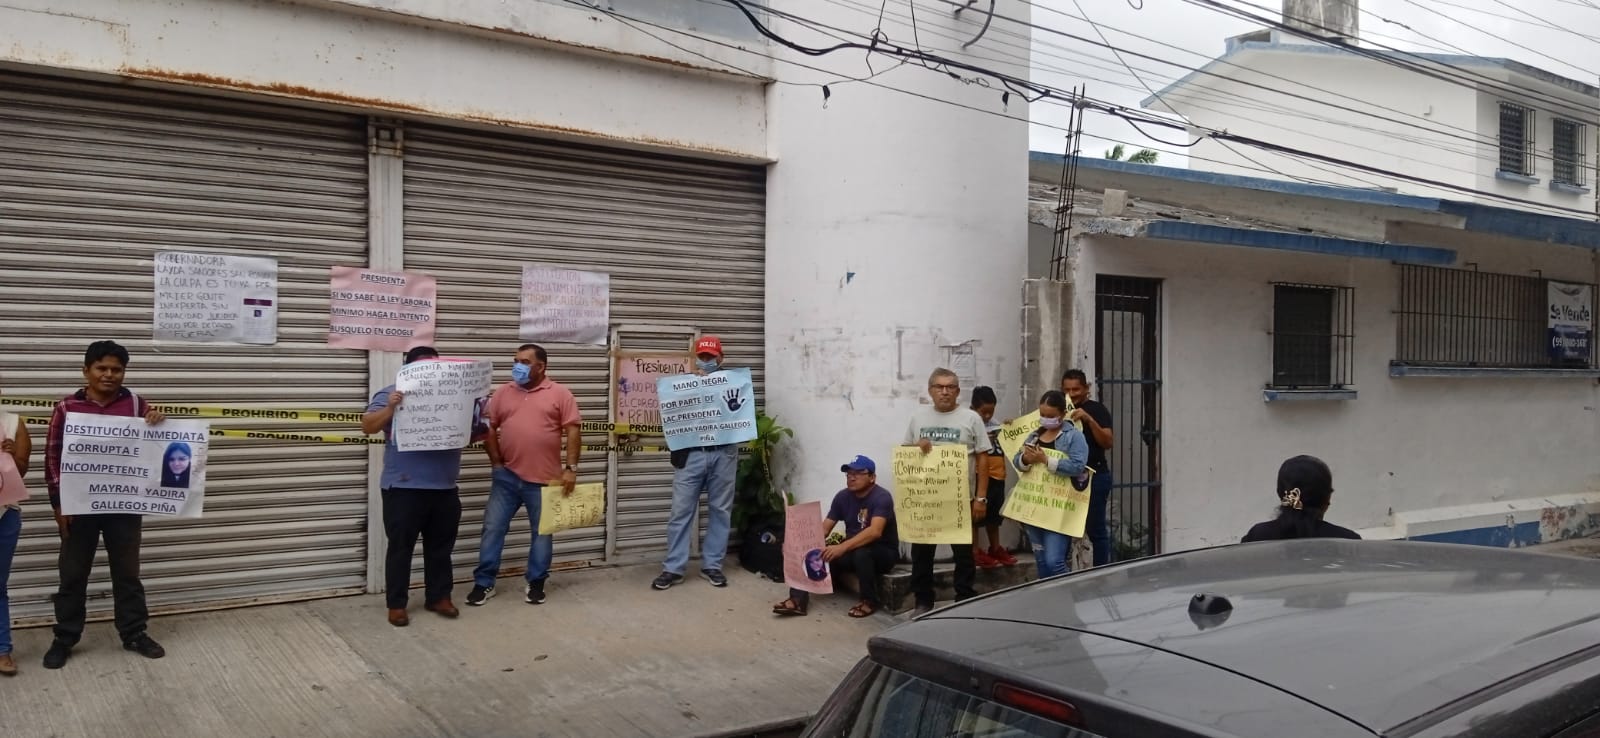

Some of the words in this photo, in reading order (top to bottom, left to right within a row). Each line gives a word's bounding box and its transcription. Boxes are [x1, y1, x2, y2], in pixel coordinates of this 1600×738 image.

[160, 277, 168, 286] LA
[174, 278, 201, 288] CULPA
[361, 274, 406, 286] PRESIDENTA
[332, 292, 339, 300] SI
[340, 292, 352, 300] NO
[354, 293, 374, 301] SABE
[401, 298, 432, 308] LABORAL
[332, 308, 363, 316] MINIMO
[367, 310, 387, 318] HAGA
[399, 313, 430, 322] INTENTO
[1562, 305, 1590, 321] Vende
[330, 325, 372, 334] BUSQUELO
[385, 328, 414, 336] GOOGLE
[673, 380, 698, 390] MANO
[701, 377, 728, 385] NEGRA
[678, 397, 701, 406] PARTE
[222, 408, 298, 419] PROHIBIDO
[678, 410, 721, 420] PRESIDENTA
[66, 424, 140, 437] DESTITUCIÓN
[143, 430, 204, 441] INMEDIATA
[665, 427, 694, 435] MAYRAN
[719, 421, 750, 429] GALLEGOS
[1003, 426, 1029, 441] Aguas
[68, 443, 130, 454] CORRUPTA
[134, 447, 140, 455] E
[61, 463, 149, 476] INCOMPETENTE
[89, 484, 138, 494] MAYRAN
[145, 488, 186, 499] YADIRA
[91, 500, 147, 510] GALLEGOS
[150, 501, 176, 512] PIÑA
